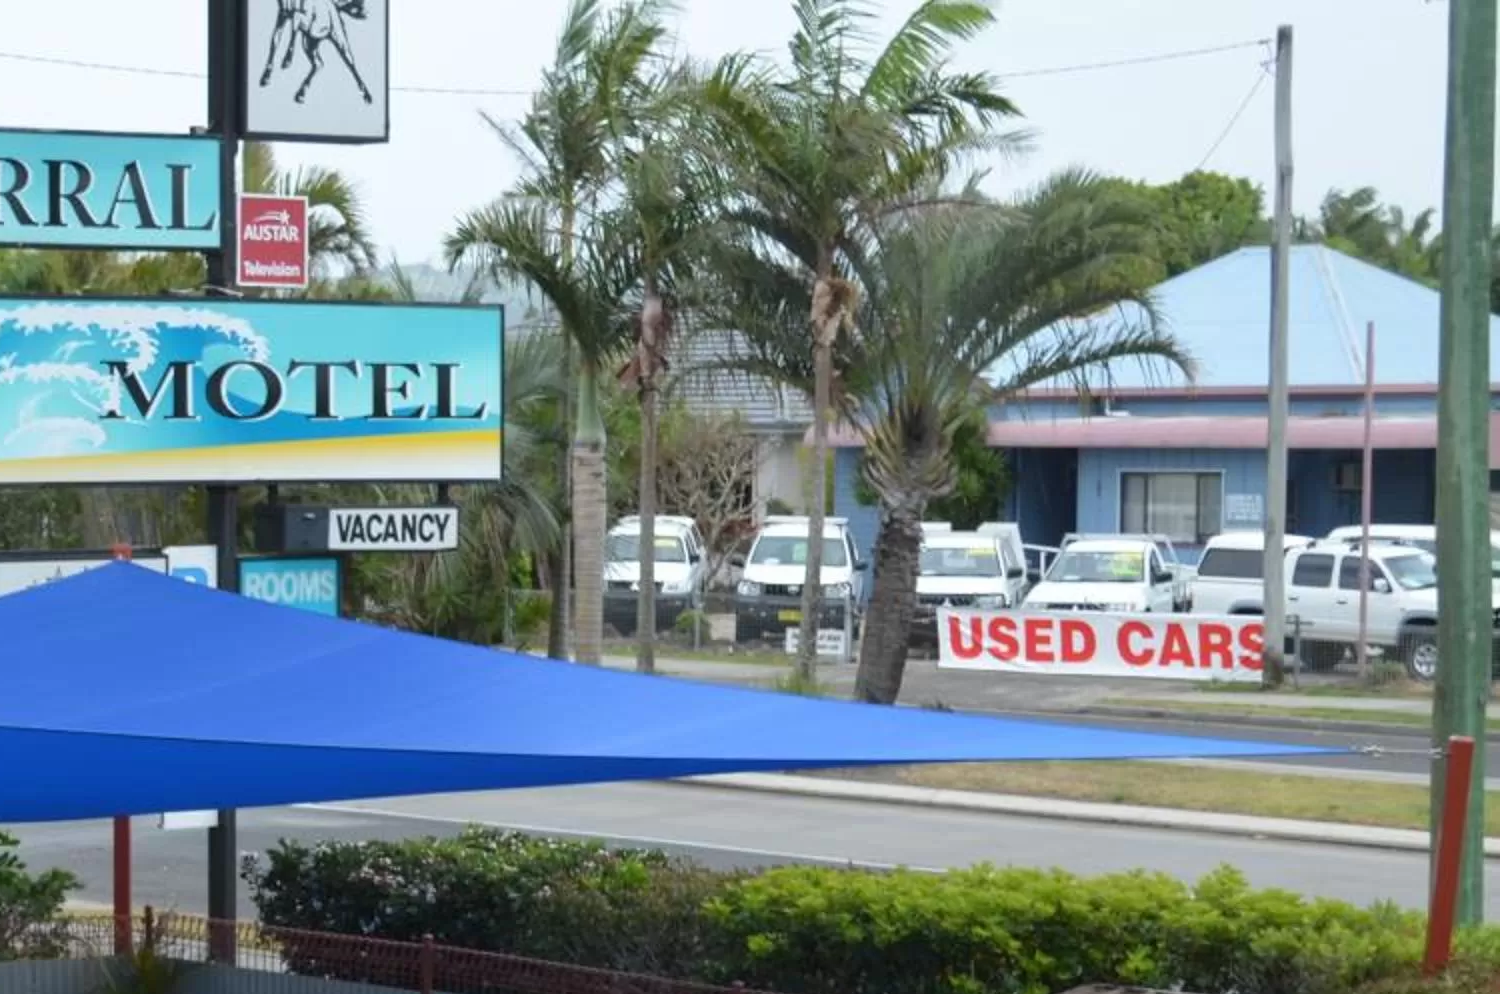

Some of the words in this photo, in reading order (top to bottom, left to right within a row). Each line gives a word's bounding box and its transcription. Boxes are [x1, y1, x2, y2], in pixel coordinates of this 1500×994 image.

[243, 223, 300, 242] AUSTAR
[243, 260, 300, 277] Television
[97, 360, 487, 422] MOTEL
[336, 513, 450, 544] VACANCY
[244, 569, 335, 604] ROOMS
[947, 615, 1097, 662] USED
[1116, 620, 1265, 671] CARS
